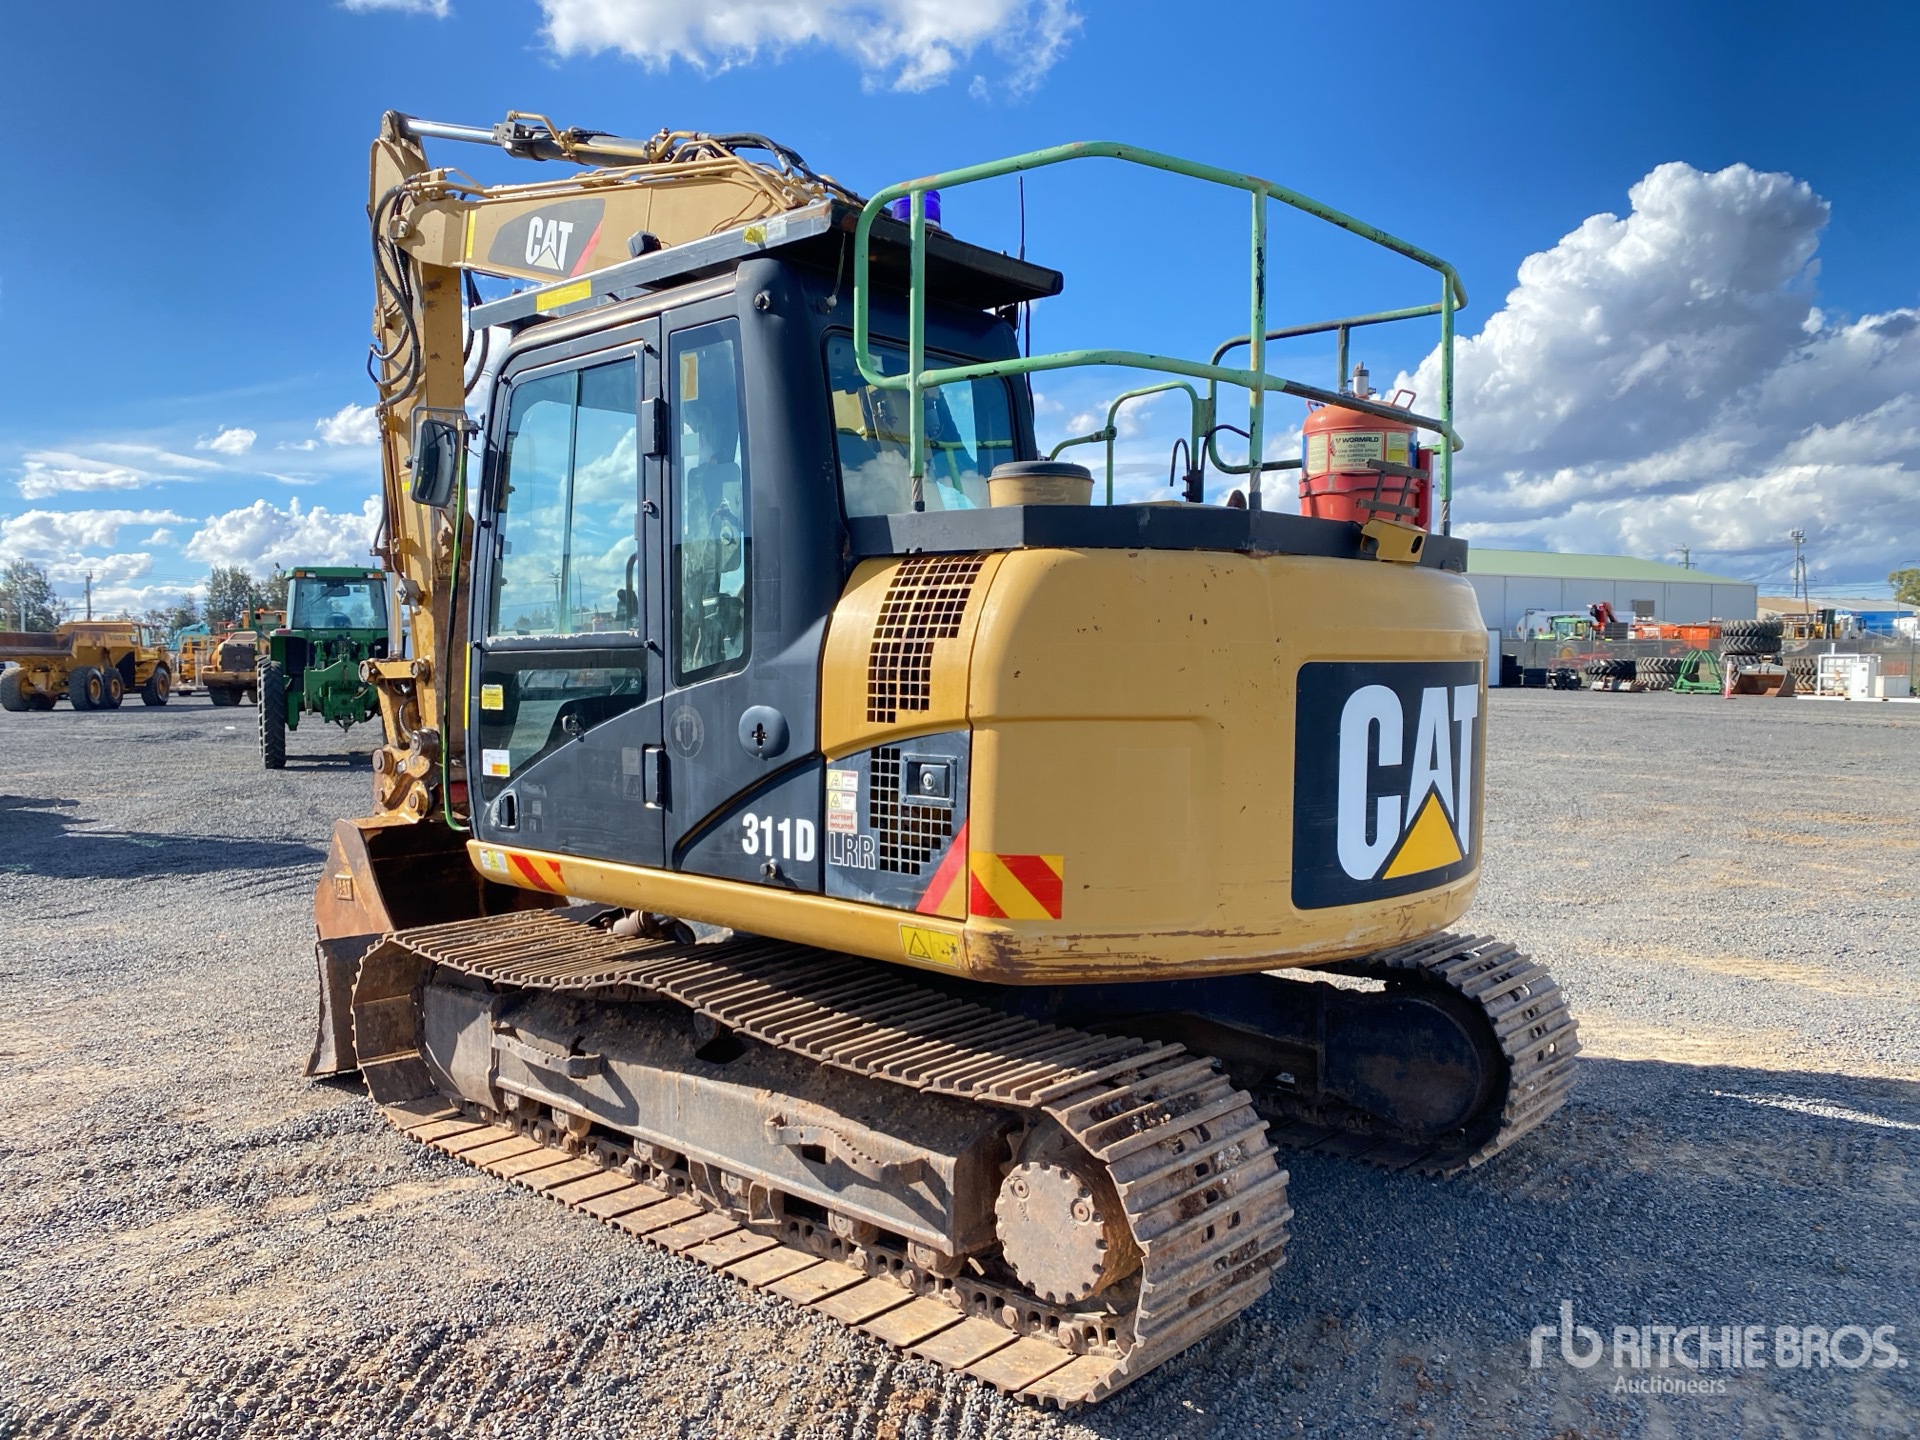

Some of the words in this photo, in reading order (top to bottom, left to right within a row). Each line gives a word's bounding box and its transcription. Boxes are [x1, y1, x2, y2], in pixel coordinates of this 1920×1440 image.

[525, 216, 574, 271] CAT
[1337, 684, 1479, 881] CAT
[742, 812, 815, 862] 311D
[830, 813, 853, 821] BATTERY
[828, 831, 876, 870] LRR
